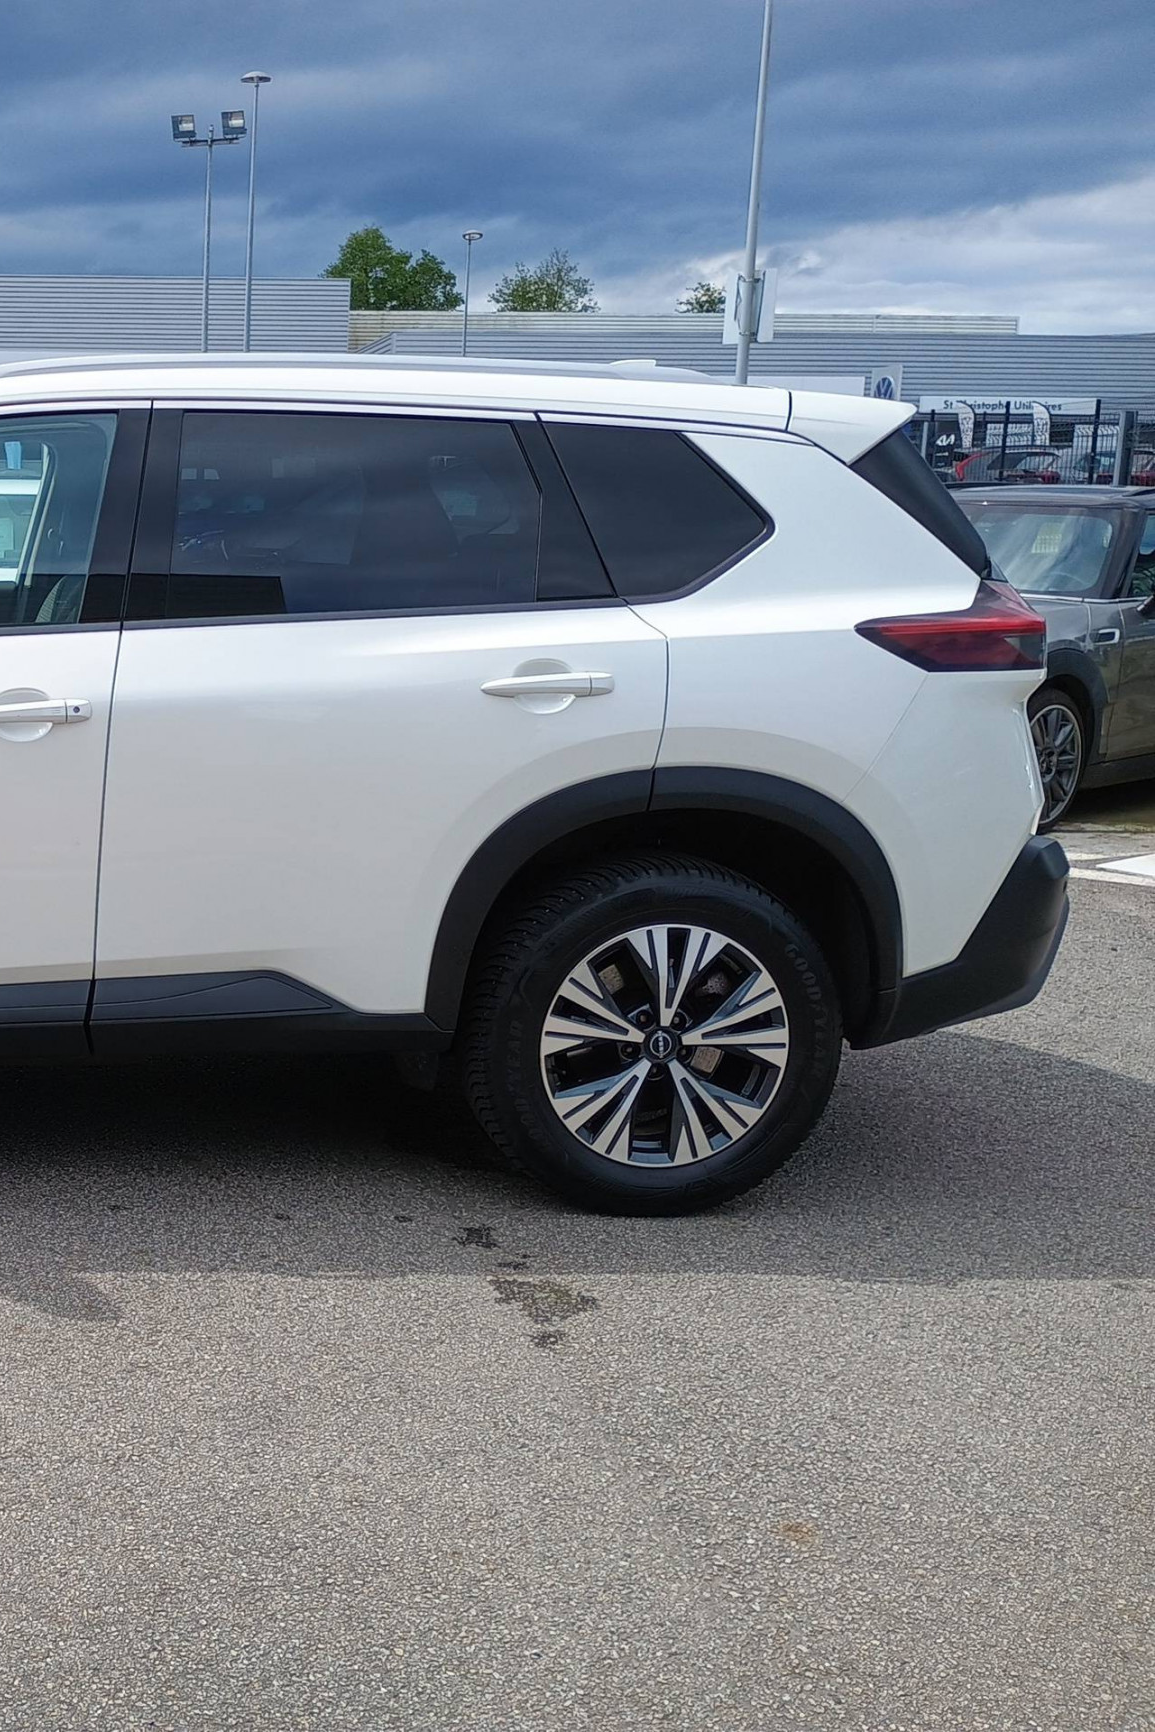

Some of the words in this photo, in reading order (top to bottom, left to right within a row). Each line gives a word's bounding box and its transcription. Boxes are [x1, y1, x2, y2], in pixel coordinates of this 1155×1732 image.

[943, 400, 953, 410] St
[956, 400, 1009, 412] ristoph
[1014, 400, 1062, 411] Utilres
